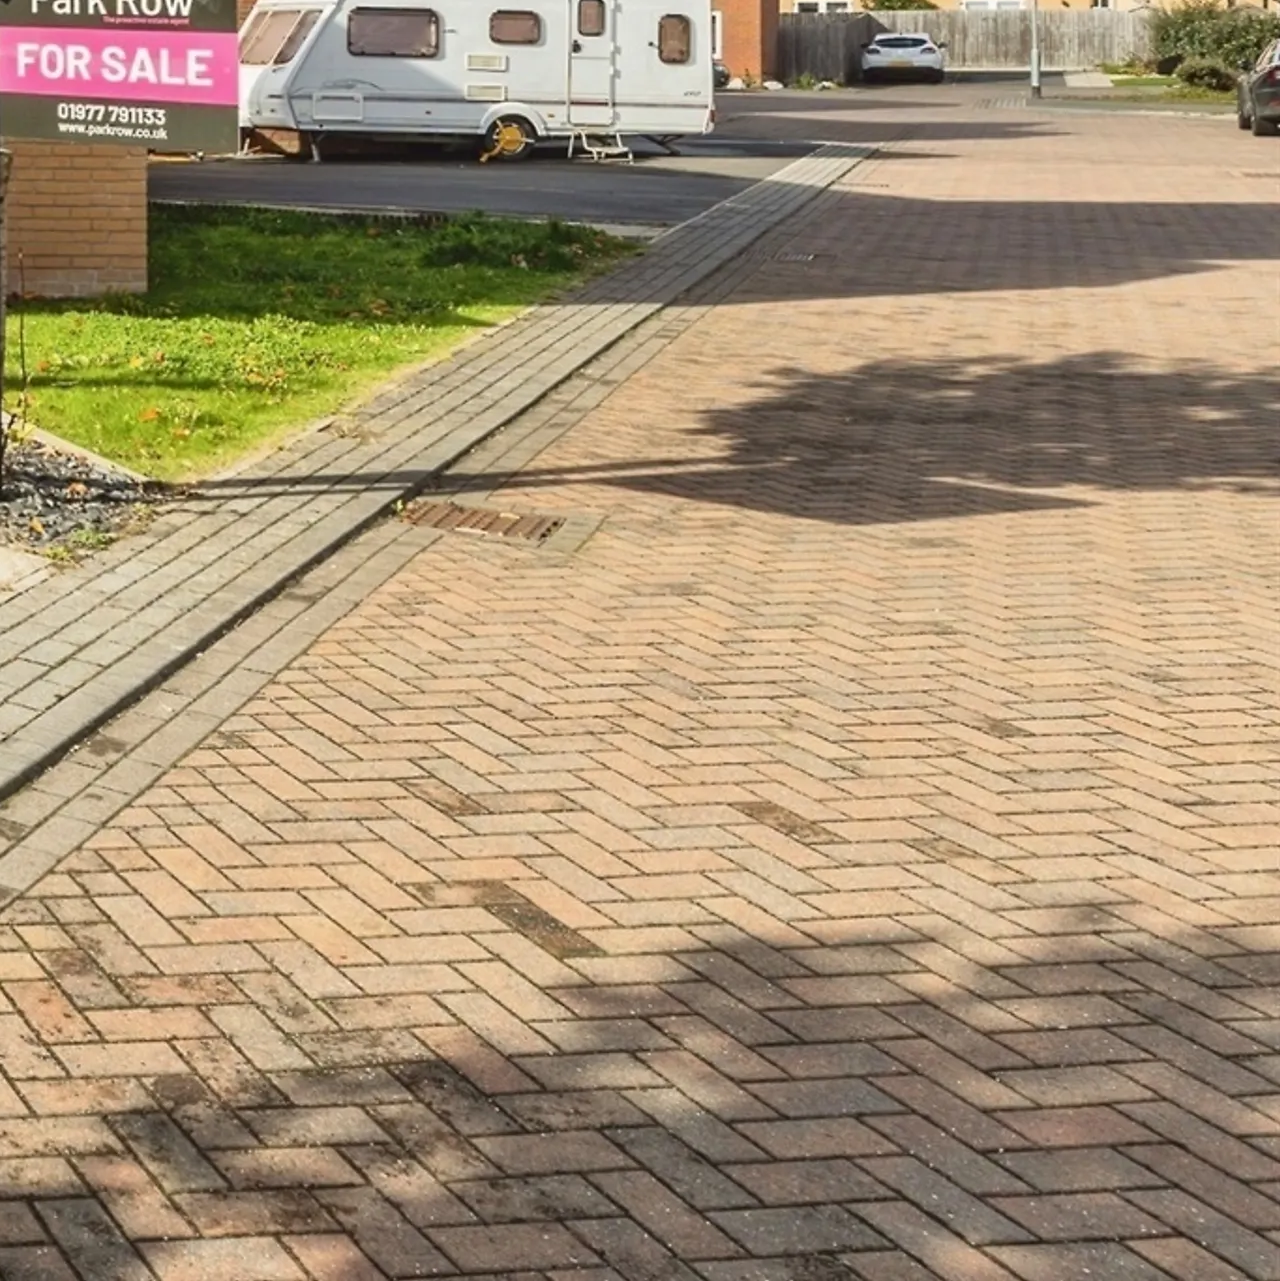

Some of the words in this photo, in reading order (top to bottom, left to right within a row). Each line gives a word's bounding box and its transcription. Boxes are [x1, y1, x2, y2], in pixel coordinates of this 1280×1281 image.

[16, 42, 92, 81] FOR
[101, 46, 213, 87] SALE
[57, 102, 105, 121] 01977
[108, 106, 166, 124] 791133
[58, 122, 167, 140] www.parkrow.co.uk
